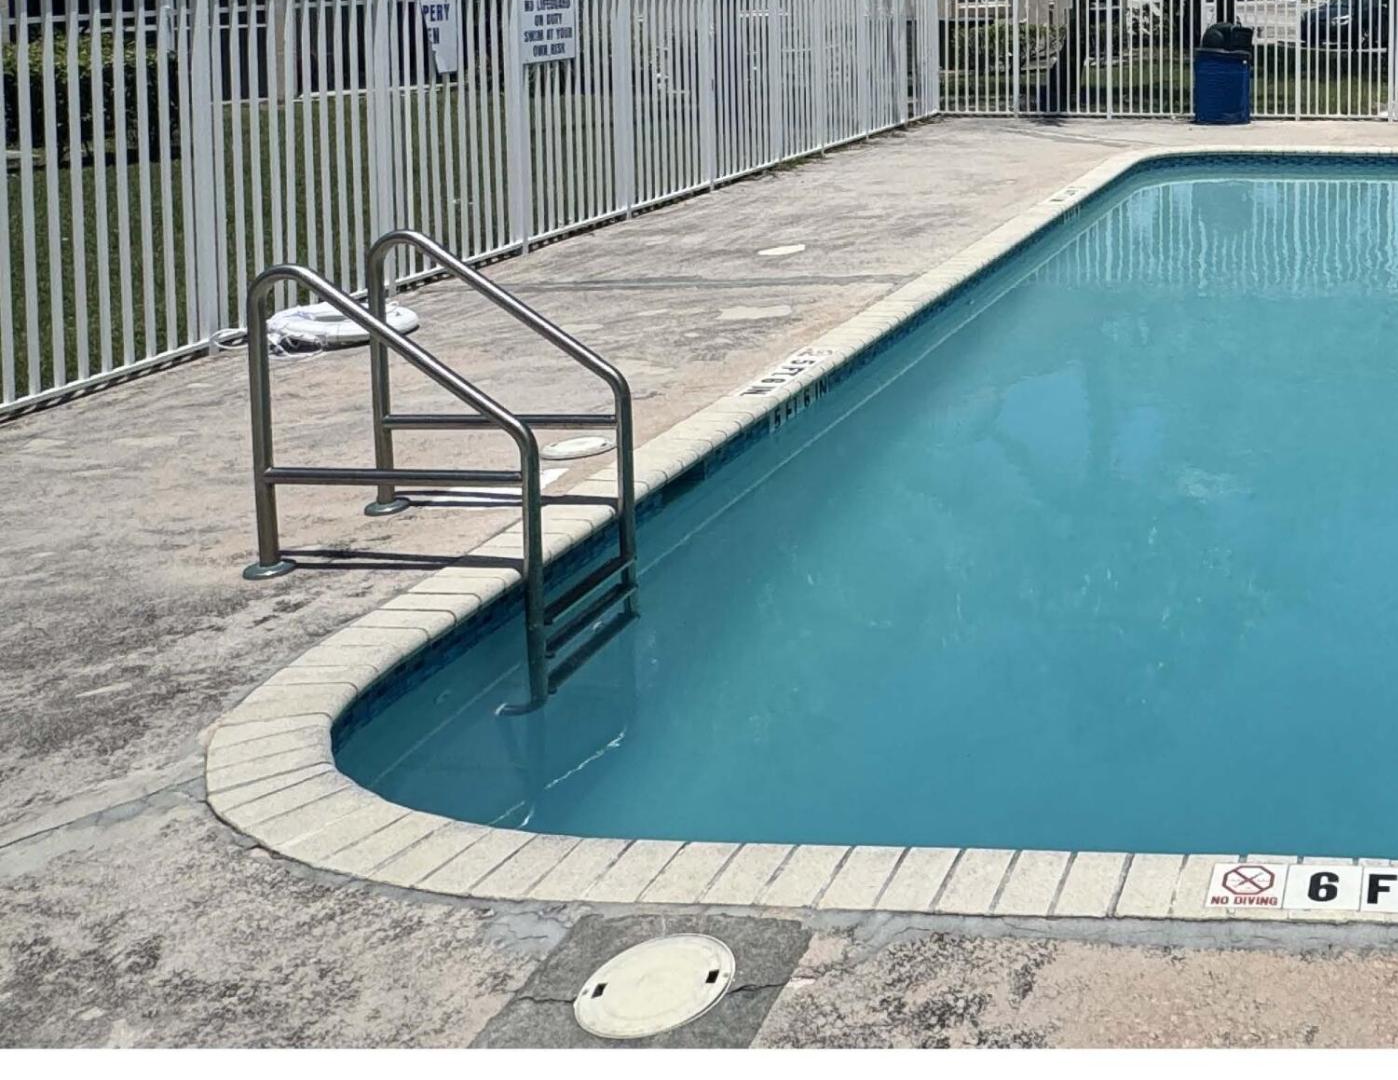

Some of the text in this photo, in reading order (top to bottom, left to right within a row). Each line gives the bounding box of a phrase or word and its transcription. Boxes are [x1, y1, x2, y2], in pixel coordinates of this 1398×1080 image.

[534, 13, 563, 26] ON DUTY
[524, 27, 573, 43] SWIM AT YOUR
[549, 43, 566, 55] RISK
[1308, 870, 1338, 902] 6
[1210, 895, 1278, 906] NO DIVING
